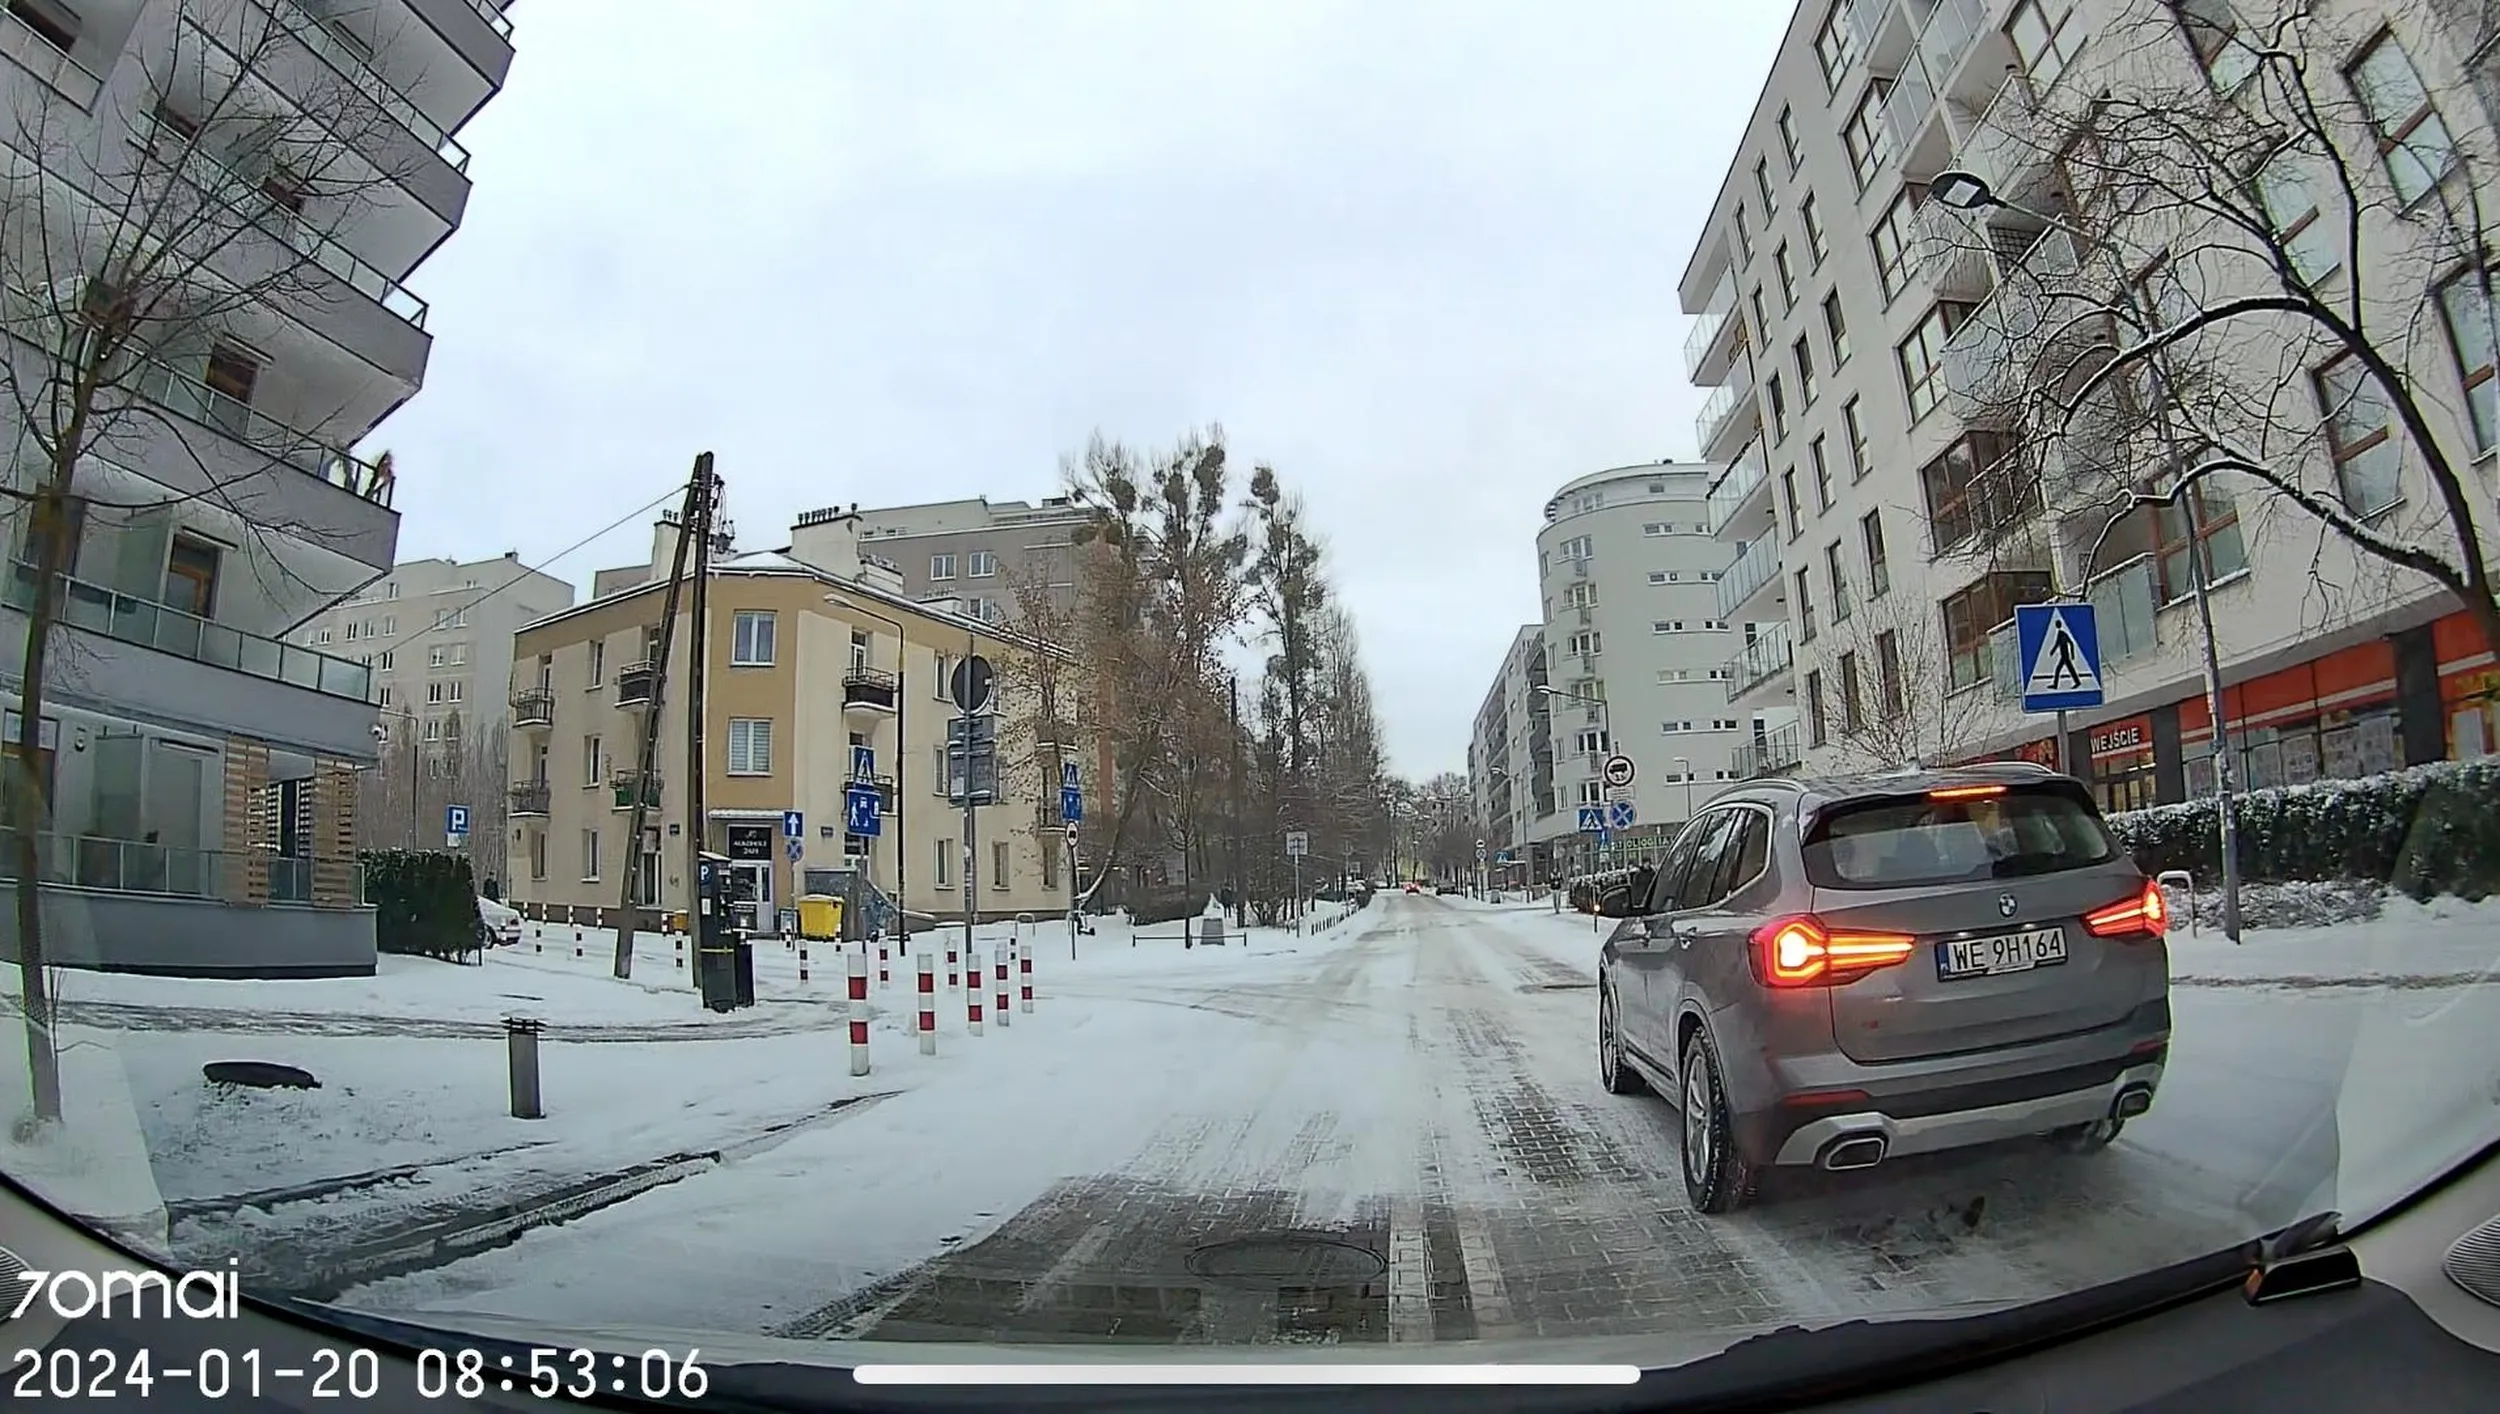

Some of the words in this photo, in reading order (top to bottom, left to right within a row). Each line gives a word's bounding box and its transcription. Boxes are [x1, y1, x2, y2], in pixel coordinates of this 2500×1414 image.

[2090, 727, 2140, 753] WEJŚCIE
[452, 809, 465, 831] P
[700, 865, 709, 881] P
[1953, 941, 1985, 970] WE
[1992, 930, 2062, 964] 9H164
